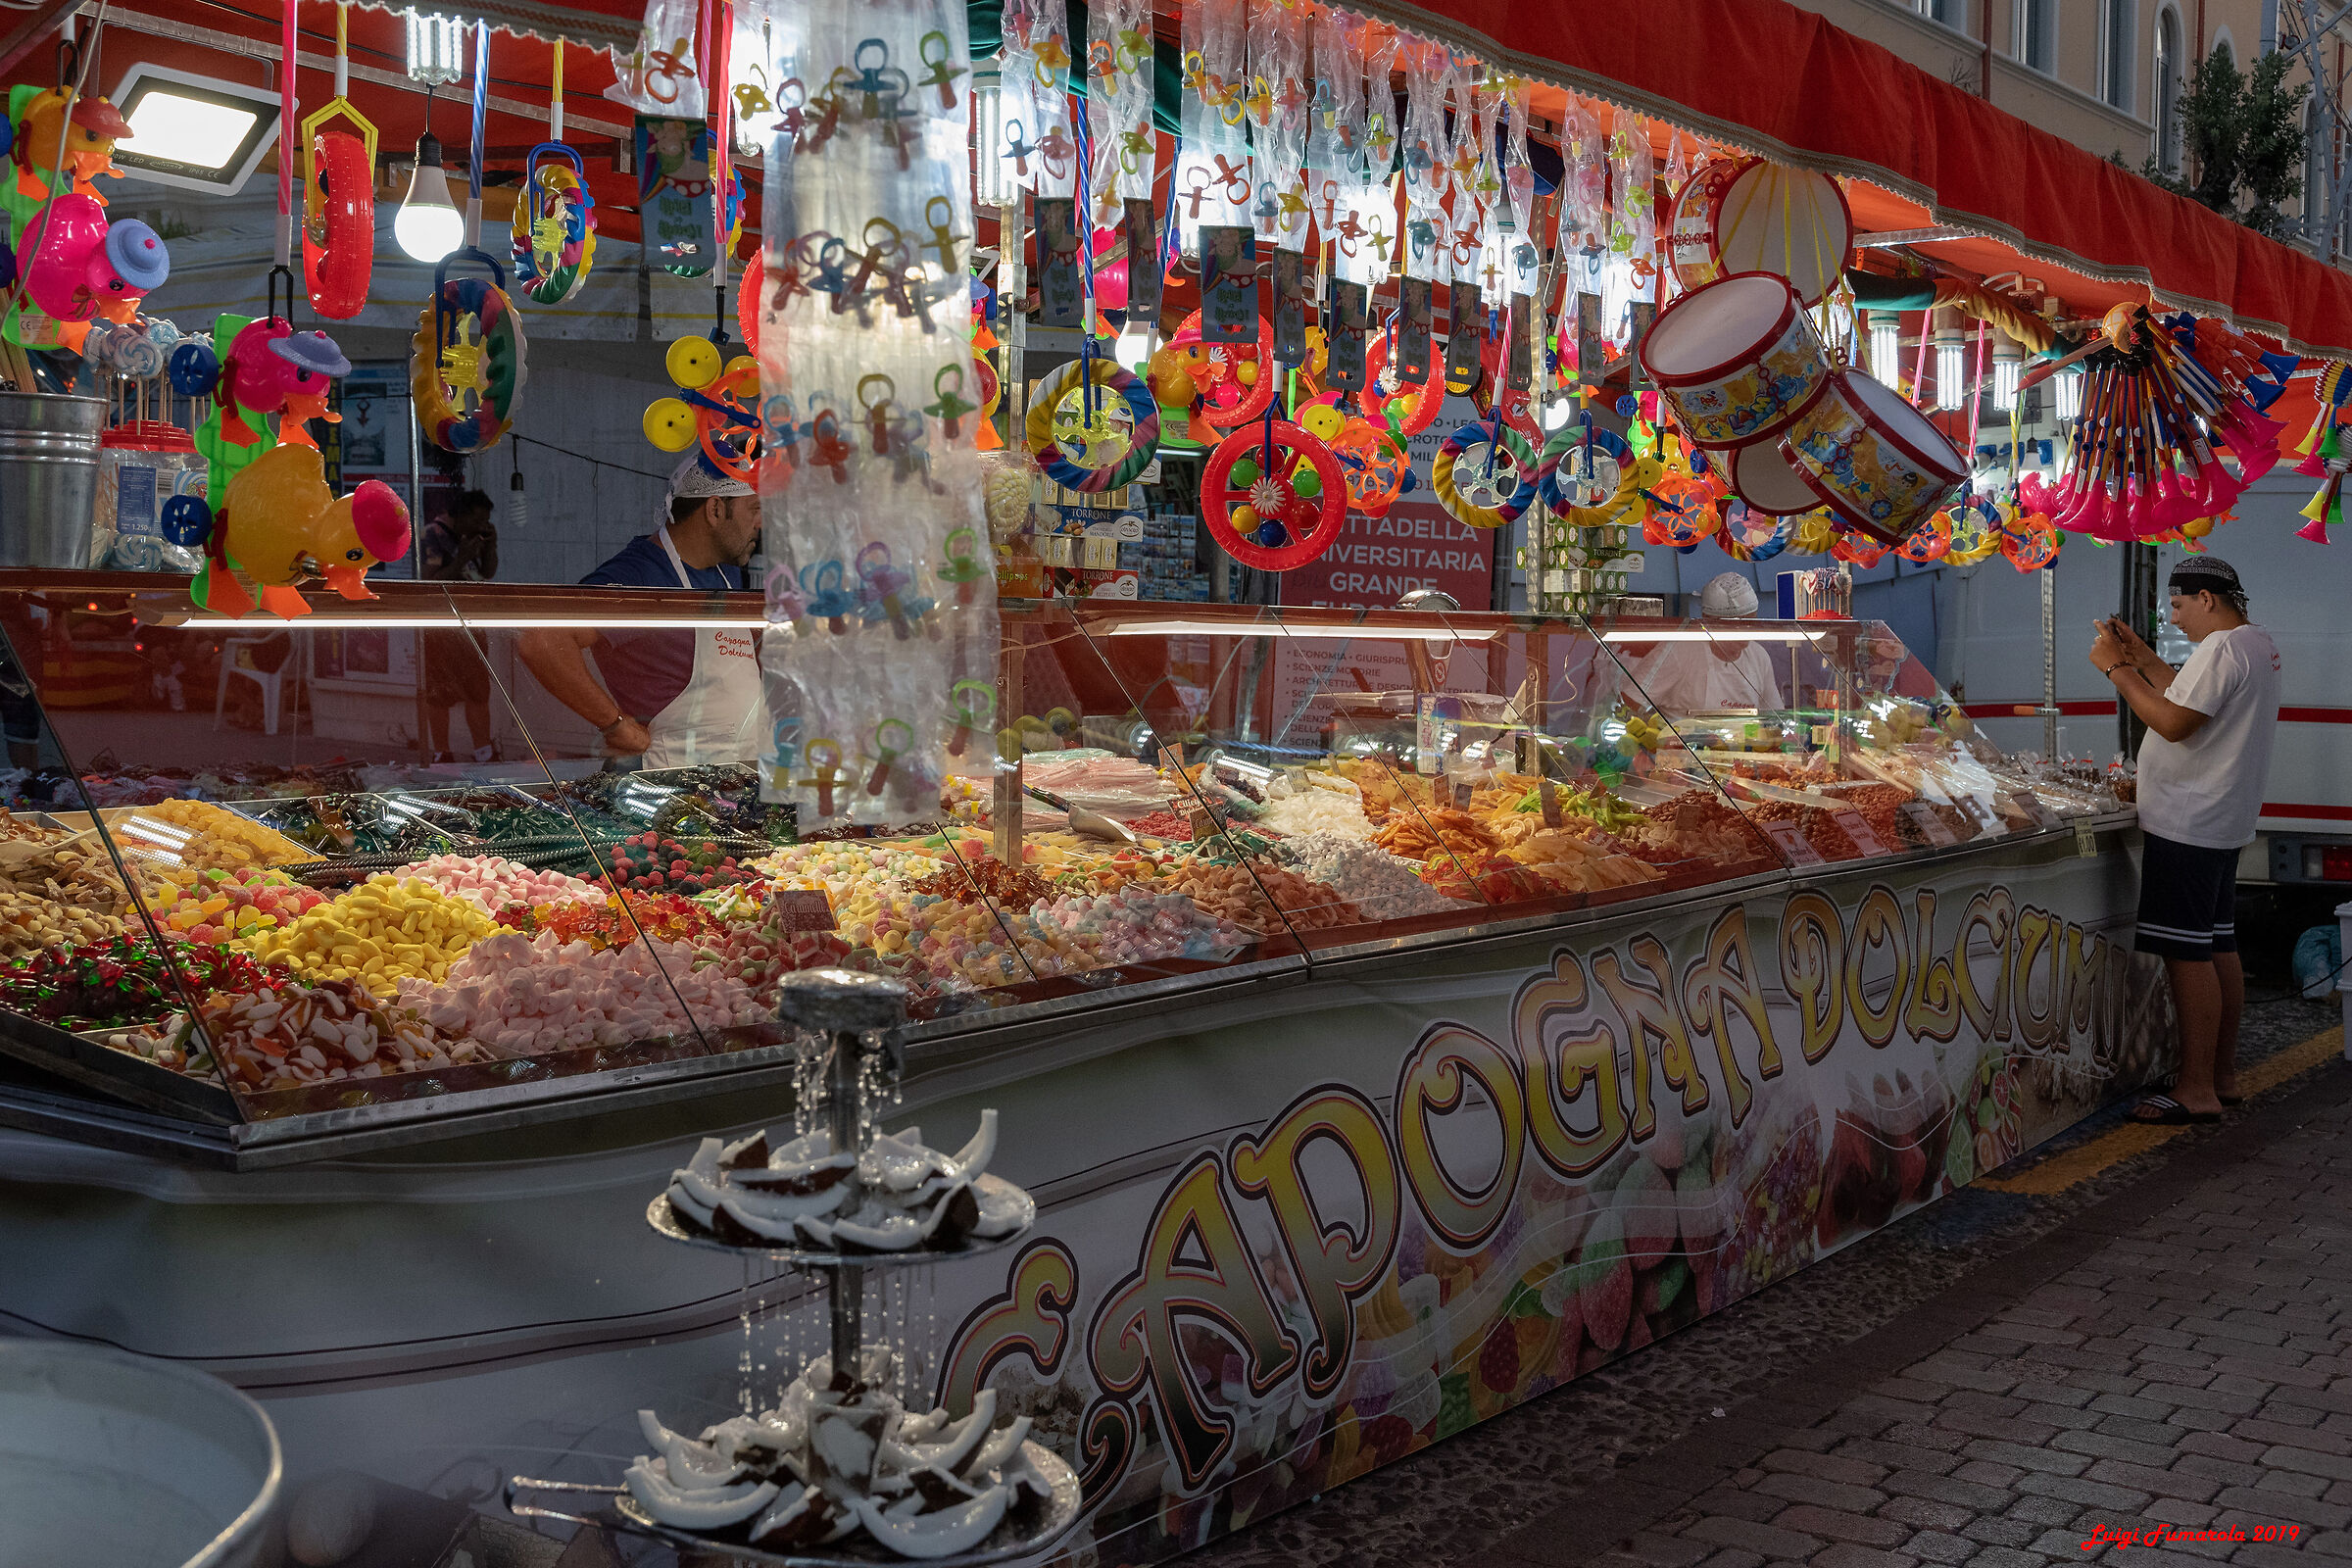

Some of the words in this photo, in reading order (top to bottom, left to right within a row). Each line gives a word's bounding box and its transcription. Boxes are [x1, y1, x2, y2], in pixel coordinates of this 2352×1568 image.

[1071, 507, 1111, 520] TORRONE
[1339, 514, 1479, 542] TTADELLA
[997, 568, 1028, 582] ollipops
[1083, 570, 1113, 581] TORRONE
[715, 630, 751, 647] Capogna
[1294, 649, 1348, 660] ECONOMIA
[1293, 662, 1334, 673] SCIENZE
[1337, 666, 1381, 677] MOORIE
[1778, 884, 2129, 1075] DOLCIUMI
